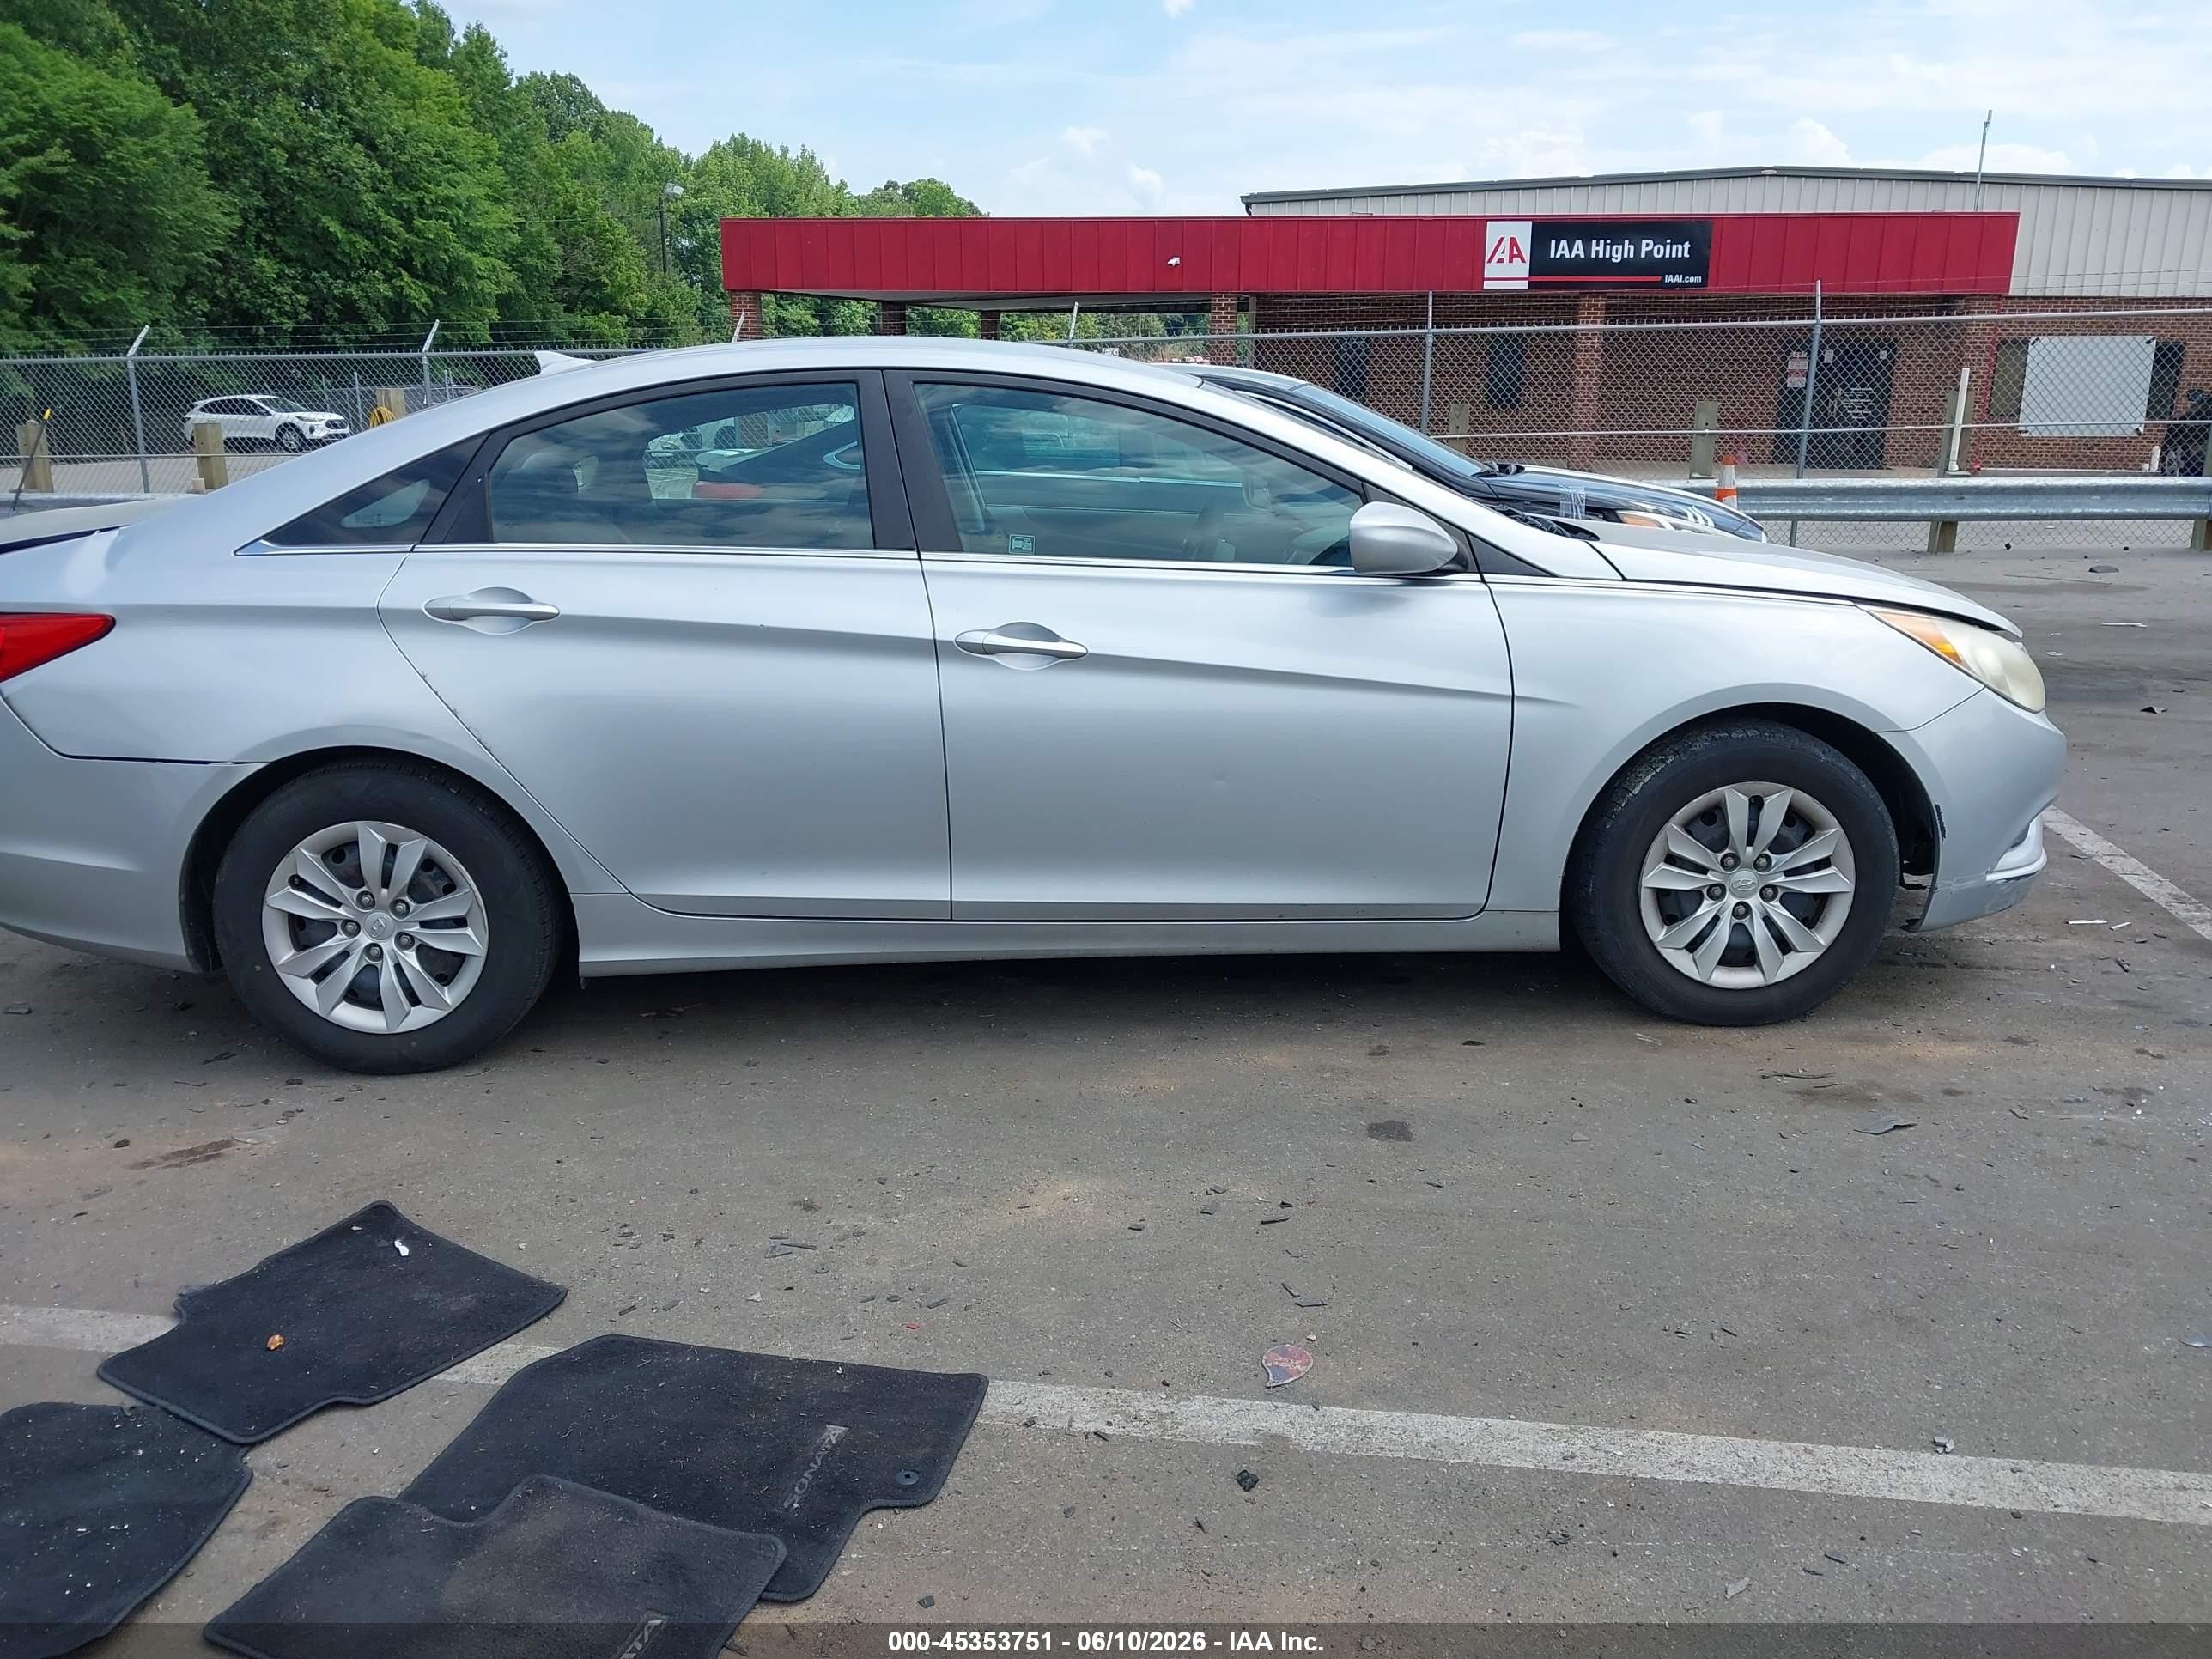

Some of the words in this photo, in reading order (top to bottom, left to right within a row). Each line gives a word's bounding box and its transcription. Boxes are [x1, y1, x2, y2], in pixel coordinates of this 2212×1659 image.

[1550, 239, 1585, 258] IAA
[1591, 239, 1635, 263] High
[1640, 239, 1691, 258] Point
[1664, 274, 1702, 283] IAAI.com
[782, 1427, 845, 1509] SONATA
